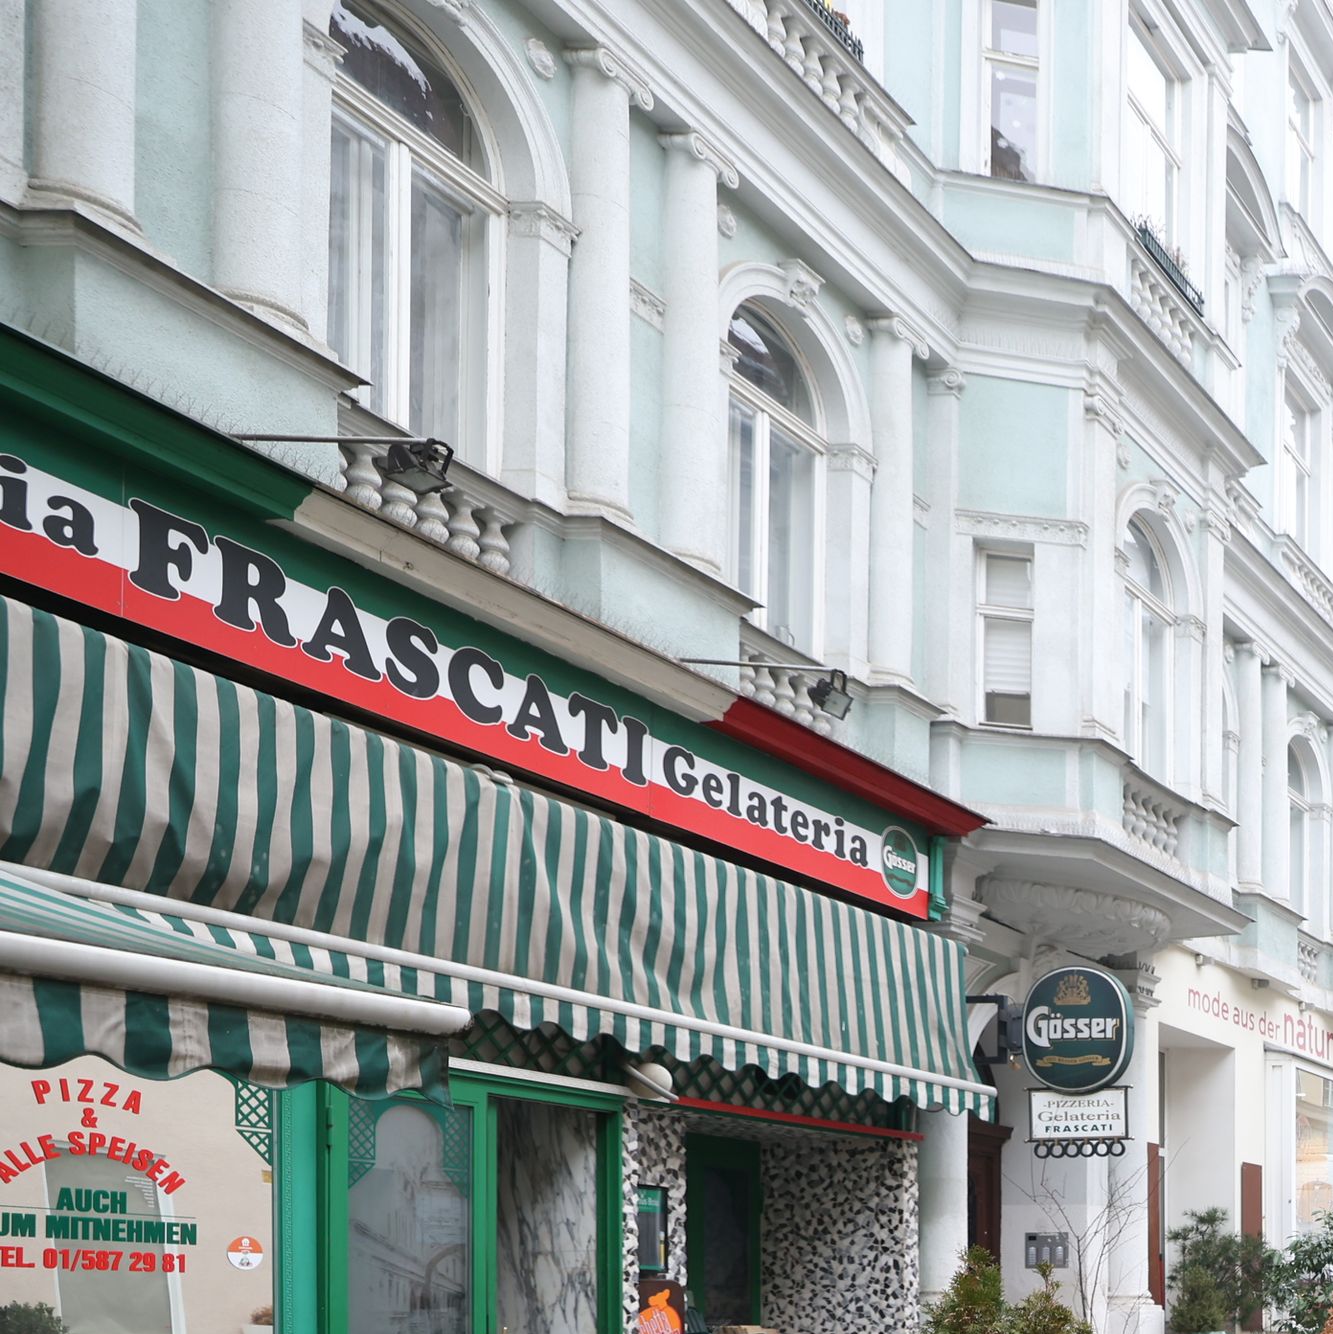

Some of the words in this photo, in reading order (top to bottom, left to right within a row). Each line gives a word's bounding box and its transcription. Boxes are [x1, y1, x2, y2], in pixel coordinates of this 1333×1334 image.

[129, 498, 648, 787] FRASCATI
[663, 747, 869, 868] Gelateria
[1026, 1005, 1120, 1048] Gösser
[1187, 987, 1229, 1022] mode
[1233, 1006, 1255, 1031] aus
[1258, 1011, 1281, 1040] der
[31, 1078, 142, 1114] PIZZA
[81, 1107, 97, 1128] &
[1038, 1110, 1121, 1123] Gelateria
[1045, 1123, 1113, 1133] FRASCATI
[68, 1131, 186, 1195] SPEISEN
[56, 1187, 127, 1214] AUCH
[45, 1214, 197, 1246] MITNEHMEN
[43, 1248, 123, 1272] 01/587
[129, 1252, 156, 1273] 29
[162, 1253, 186, 1273] 81
